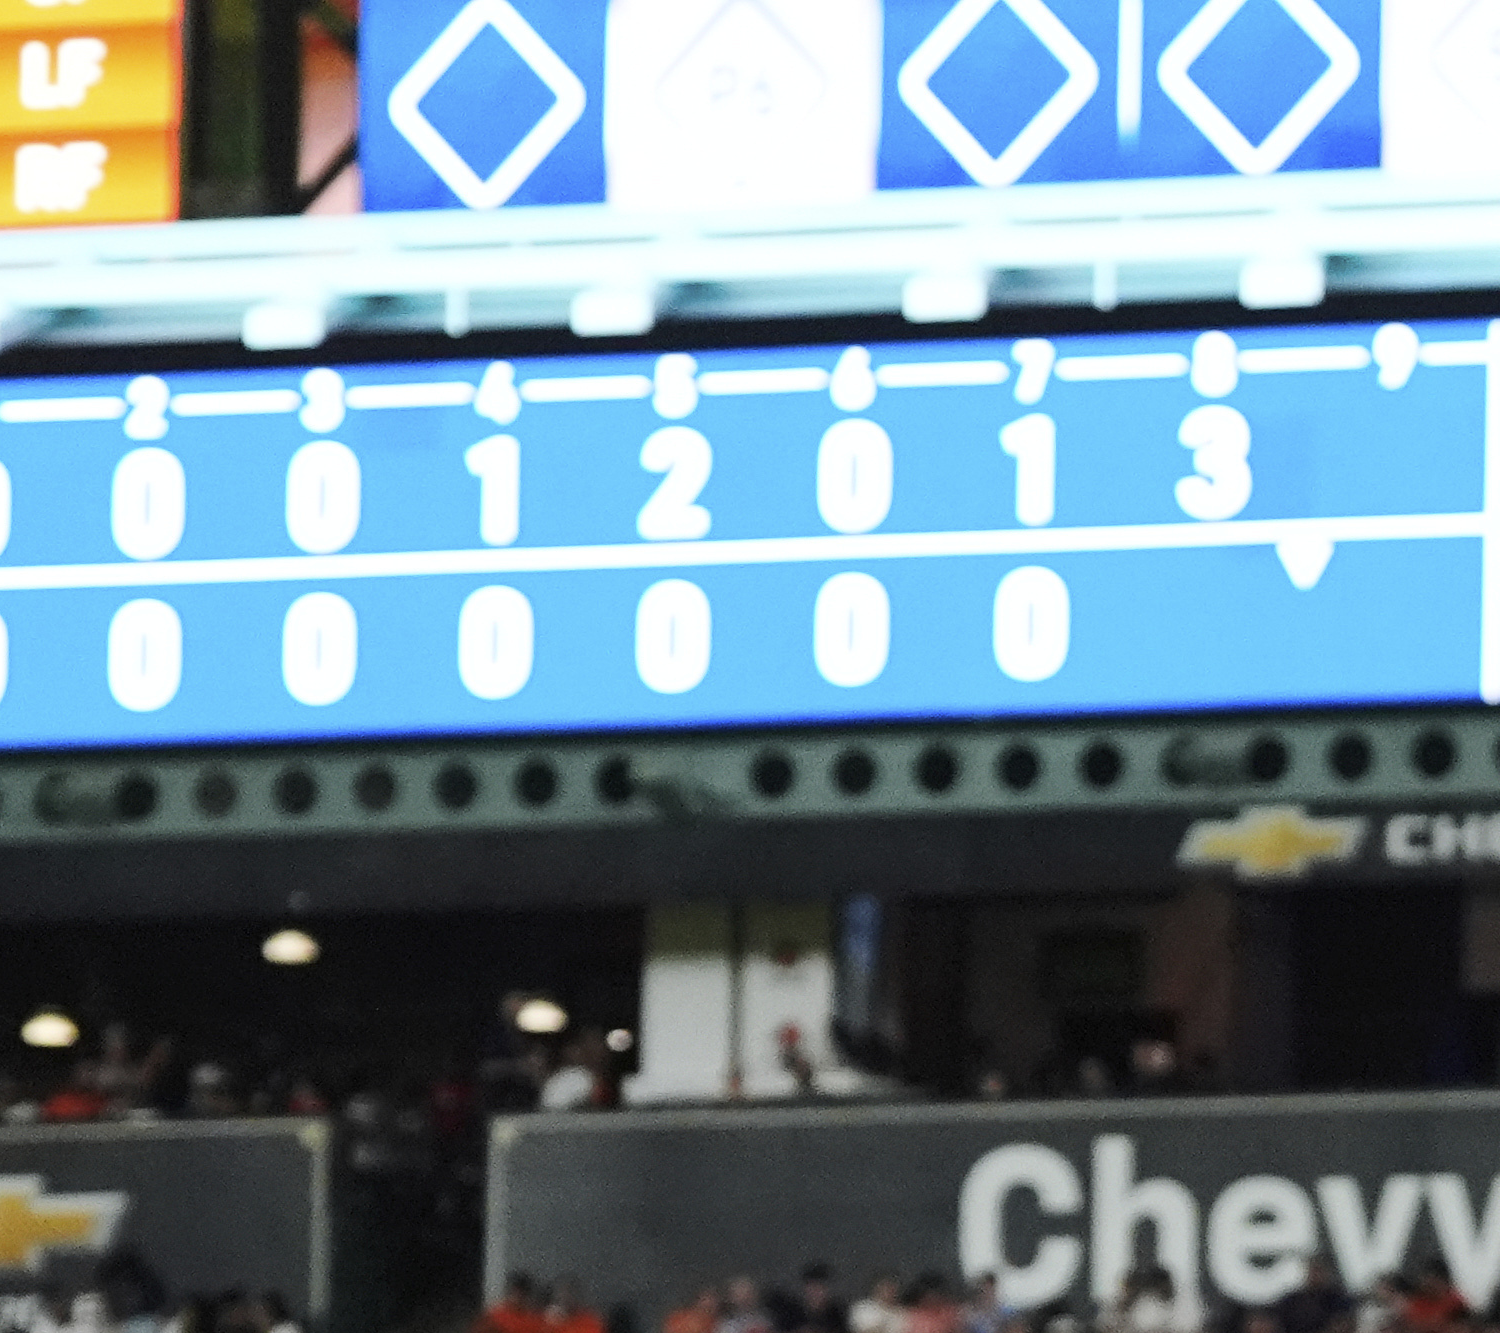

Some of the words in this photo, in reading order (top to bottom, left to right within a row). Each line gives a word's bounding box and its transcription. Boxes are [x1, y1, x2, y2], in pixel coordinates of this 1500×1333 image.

[18, 37, 107, 111] LF
[124, 375, 170, 441] 2
[1012, 338, 1055, 405] 7
[1190, 330, 1239, 398] 8
[1372, 322, 1419, 391] 9
[111, 446, 186, 561] 0
[285, 439, 361, 554] 0
[464, 433, 521, 546] 1
[636, 426, 713, 541] 2
[816, 418, 894, 534] 0
[999, 412, 1057, 526] 1
[1174, 404, 1253, 521] 3
[107, 597, 182, 713] 0
[282, 591, 358, 707] 0
[458, 584, 534, 700] 0
[635, 578, 712, 695] 0
[813, 571, 891, 688] 0
[992, 564, 1070, 682] 0
